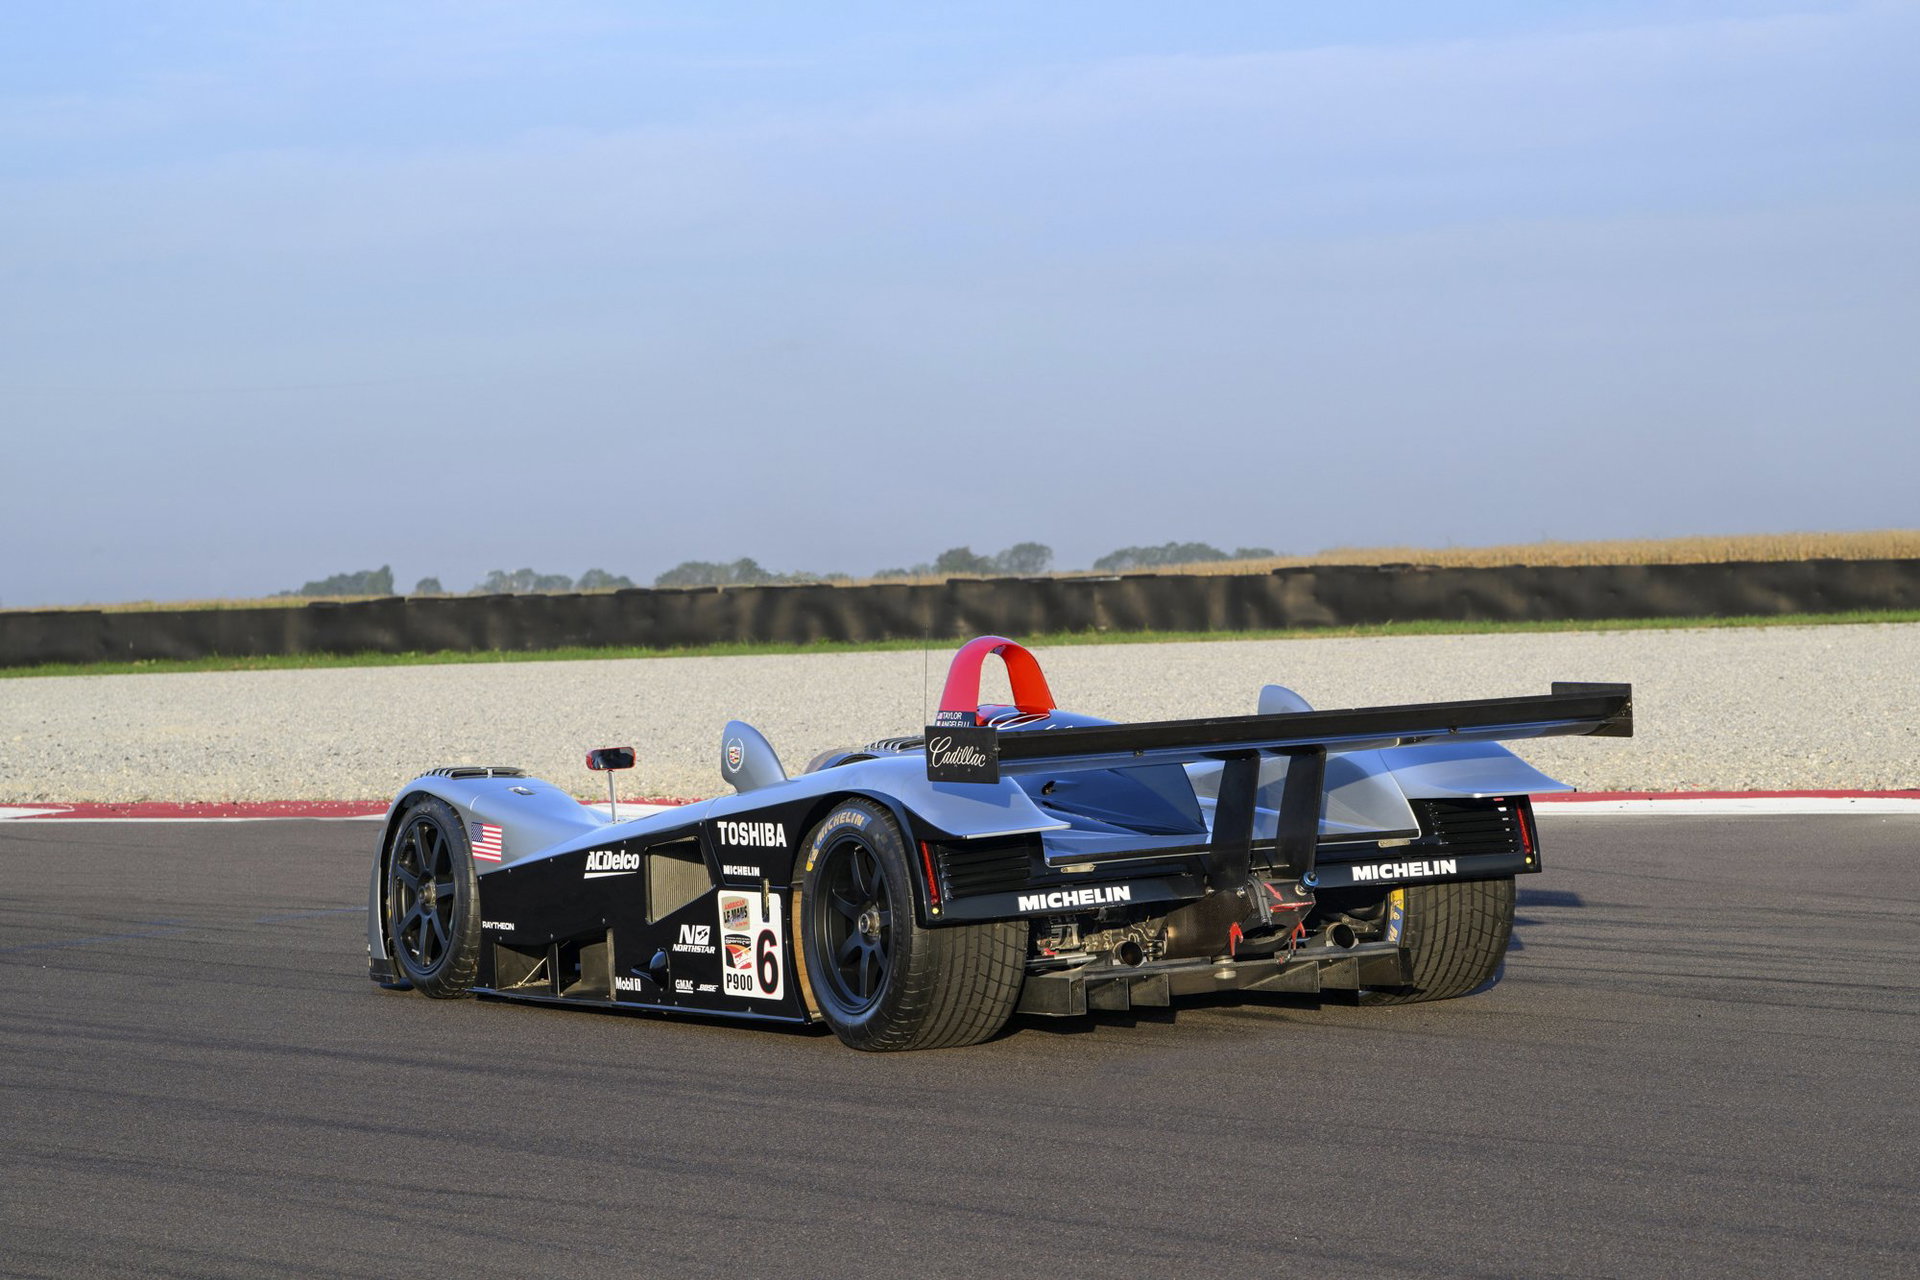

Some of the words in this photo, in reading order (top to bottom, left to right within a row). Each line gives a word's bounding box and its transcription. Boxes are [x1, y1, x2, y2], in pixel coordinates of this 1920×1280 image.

[943, 712, 963, 720] TAYLOR
[929, 736, 986, 768] Cadillac
[717, 821, 788, 848] TOSHIBA
[816, 811, 865, 846] MICHELIN
[585, 850, 640, 871] ACDelco
[723, 865, 760, 876] MICHELIN
[1352, 859, 1457, 881] MICHELIN
[1018, 885, 1131, 912] MICHELIN
[482, 921, 515, 931] RAYTHEON
[672, 944, 716, 954] NORTHSTAR
[756, 928, 779, 995] 6
[615, 976, 634, 991] Mobil
[675, 979, 694, 990] GMAC
[697, 984, 719, 992] BOSE
[726, 973, 753, 991] P900
